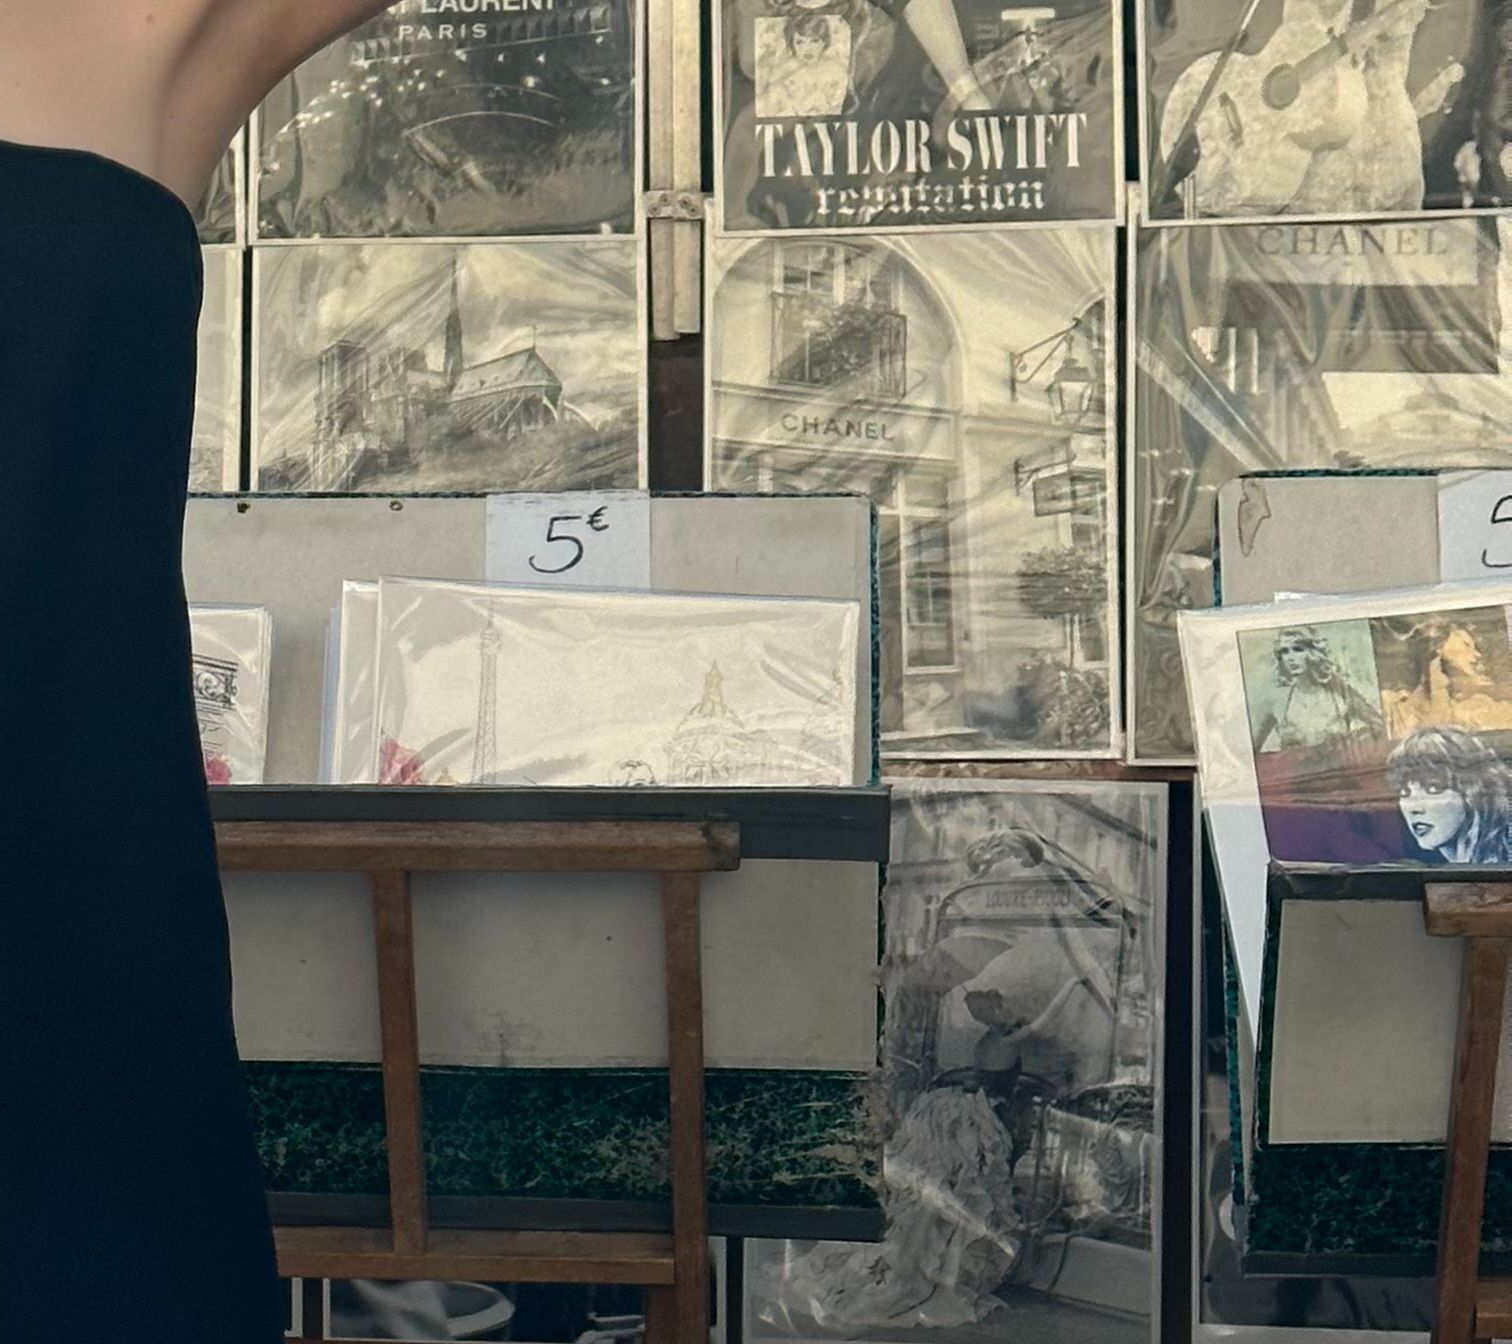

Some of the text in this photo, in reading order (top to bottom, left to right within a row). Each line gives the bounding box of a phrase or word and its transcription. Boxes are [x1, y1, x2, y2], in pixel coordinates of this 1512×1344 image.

[398, 23, 488, 41] PARIS
[755, 112, 1087, 178] TAYLOR SWIFT
[816, 174, 1045, 224] reputation
[1256, 225, 1448, 256] CHANEL
[781, 413, 894, 442] CHANEL
